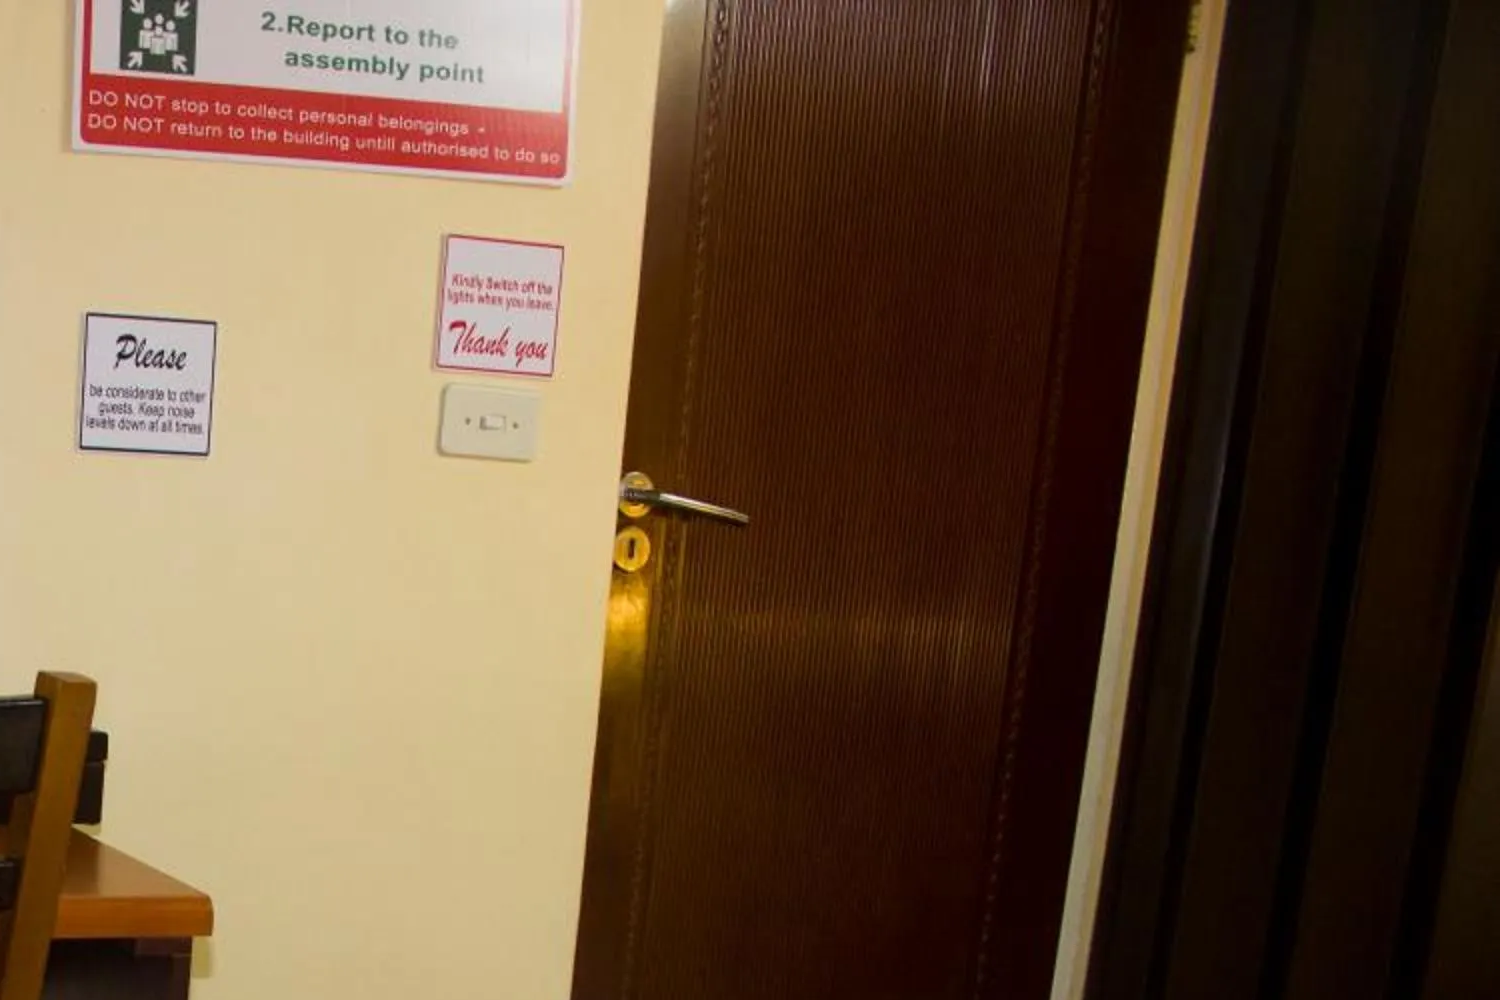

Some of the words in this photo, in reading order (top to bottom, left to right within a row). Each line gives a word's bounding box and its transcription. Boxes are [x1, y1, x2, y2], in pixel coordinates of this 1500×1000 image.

[385, 26, 409, 45] to
[418, 29, 458, 49] the
[284, 50, 410, 80] assembly
[419, 63, 484, 83] point
[89, 90, 118, 107] DO
[125, 92, 166, 111] NOT
[171, 99, 209, 115] stop
[215, 101, 231, 115] to
[237, 105, 293, 121] collect
[299, 109, 373, 126] personal
[378, 115, 469, 137] belongings
[88, 113, 117, 130] DO
[123, 117, 164, 133] NOT
[170, 121, 222, 136] return
[228, 126, 245, 140] to
[251, 126, 277, 141] the
[283, 130, 349, 151] building
[401, 139, 489, 158] authorised
[495, 147, 510, 161] to
[515, 147, 535, 163] do
[540, 151, 561, 165] so
[506, 296, 525, 312] you
[113, 333, 188, 371] Please
[449, 320, 511, 357] Thank
[515, 341, 548, 368] you
[89, 383, 103, 397] be
[105, 385, 165, 401] considerate
[167, 388, 177, 402] to
[179, 390, 206, 403] other
[86, 416, 116, 430] levels
[117, 419, 147, 432] down
[148, 420, 160, 433] at
[161, 421, 173, 434] all
[138, 403, 165, 418] Keep
[167, 406, 196, 419] noise
